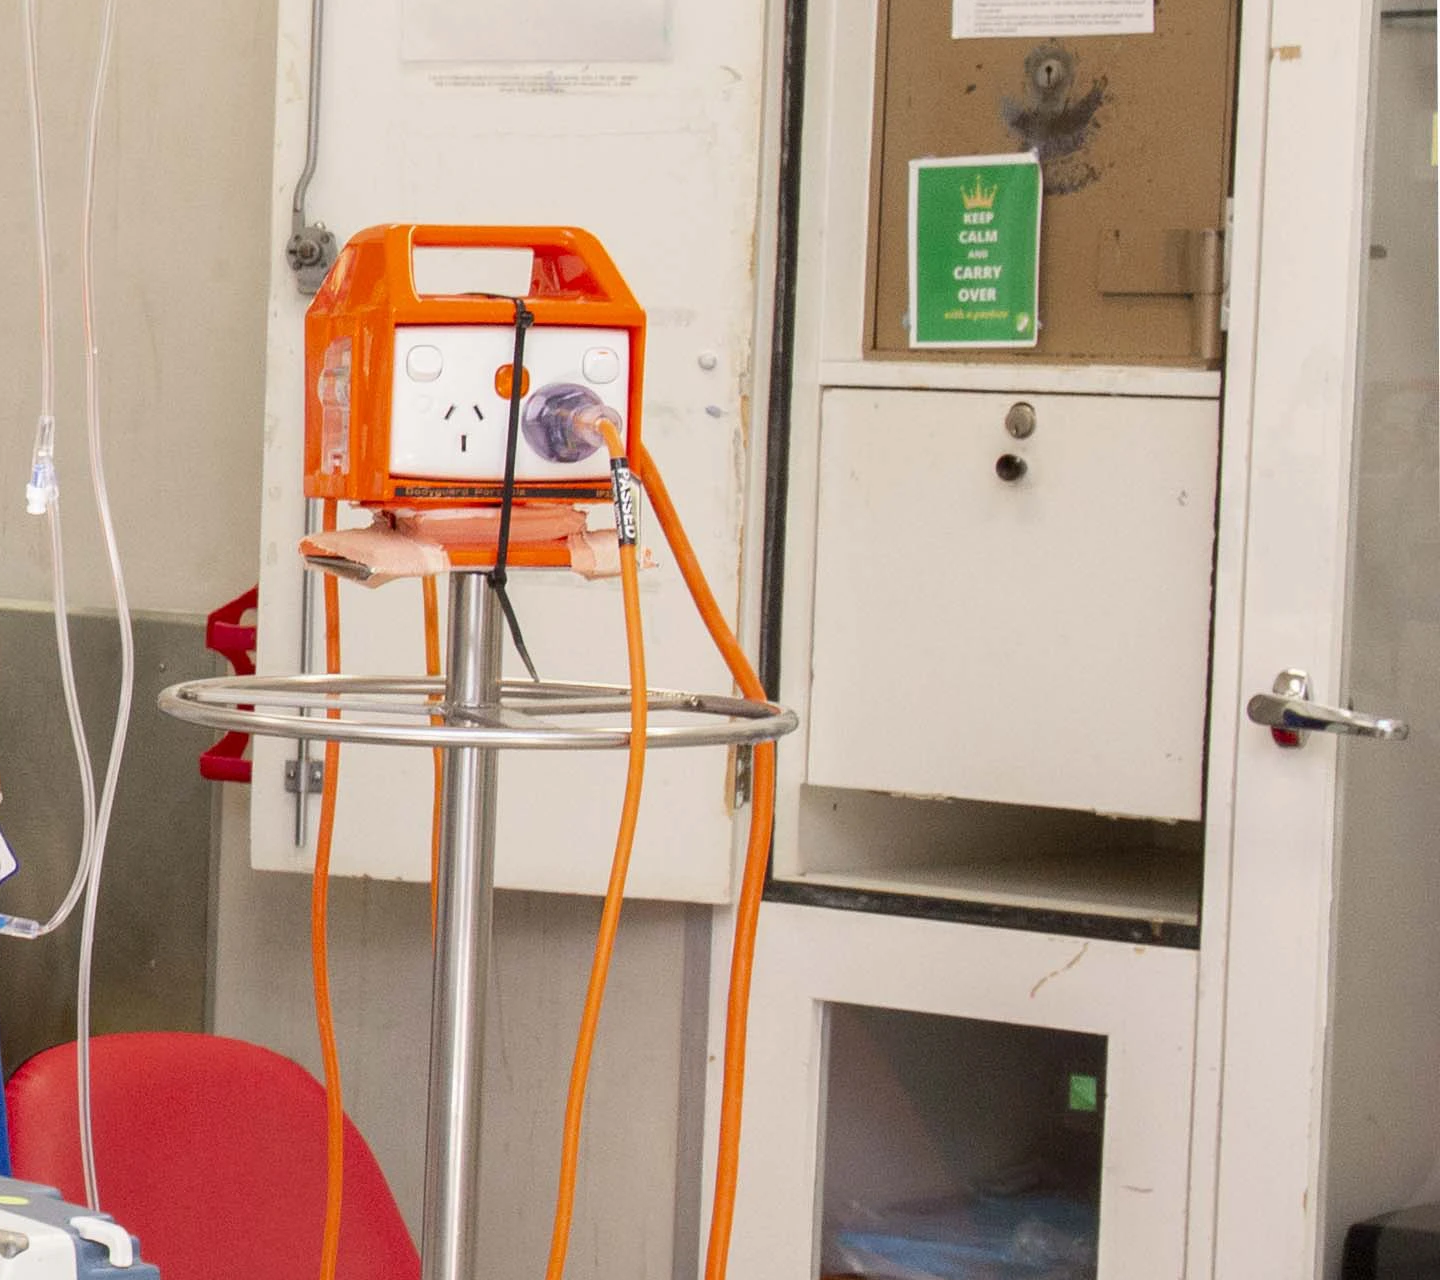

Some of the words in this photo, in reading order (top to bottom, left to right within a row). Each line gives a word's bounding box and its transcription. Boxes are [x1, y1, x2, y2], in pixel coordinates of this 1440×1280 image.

[963, 211, 994, 224] KEEP
[959, 230, 998, 243] CALM
[968, 249, 988, 259] AND
[953, 265, 1002, 280] CARRY
[958, 287, 996, 302] OVER
[617, 467, 636, 539] PASSED
